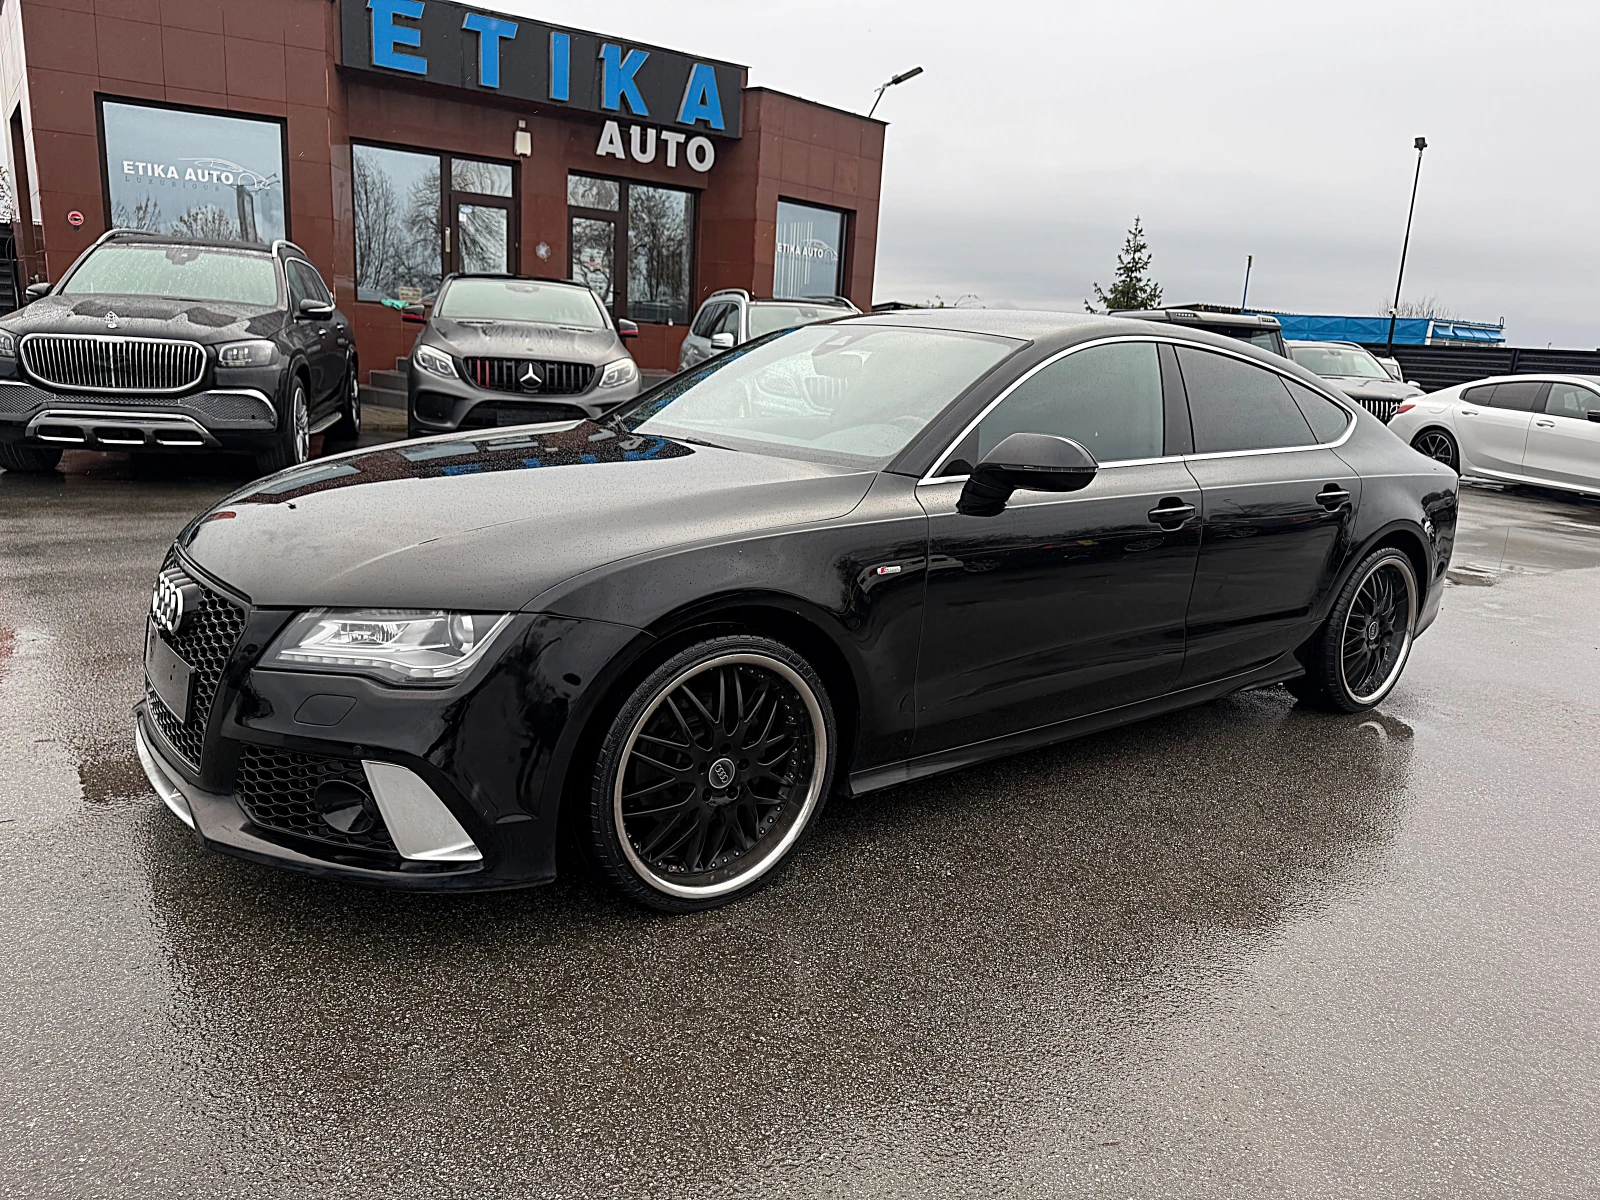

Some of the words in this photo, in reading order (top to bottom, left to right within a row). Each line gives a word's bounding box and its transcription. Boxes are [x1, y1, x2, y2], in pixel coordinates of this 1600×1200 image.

[366, 0, 726, 131] ETIKA
[595, 120, 716, 173] AUTO
[122, 160, 179, 180] ETIKA
[184, 167, 234, 185] AUTO
[777, 242, 801, 255] ETIKA
[802, 246, 824, 259] AUTO
